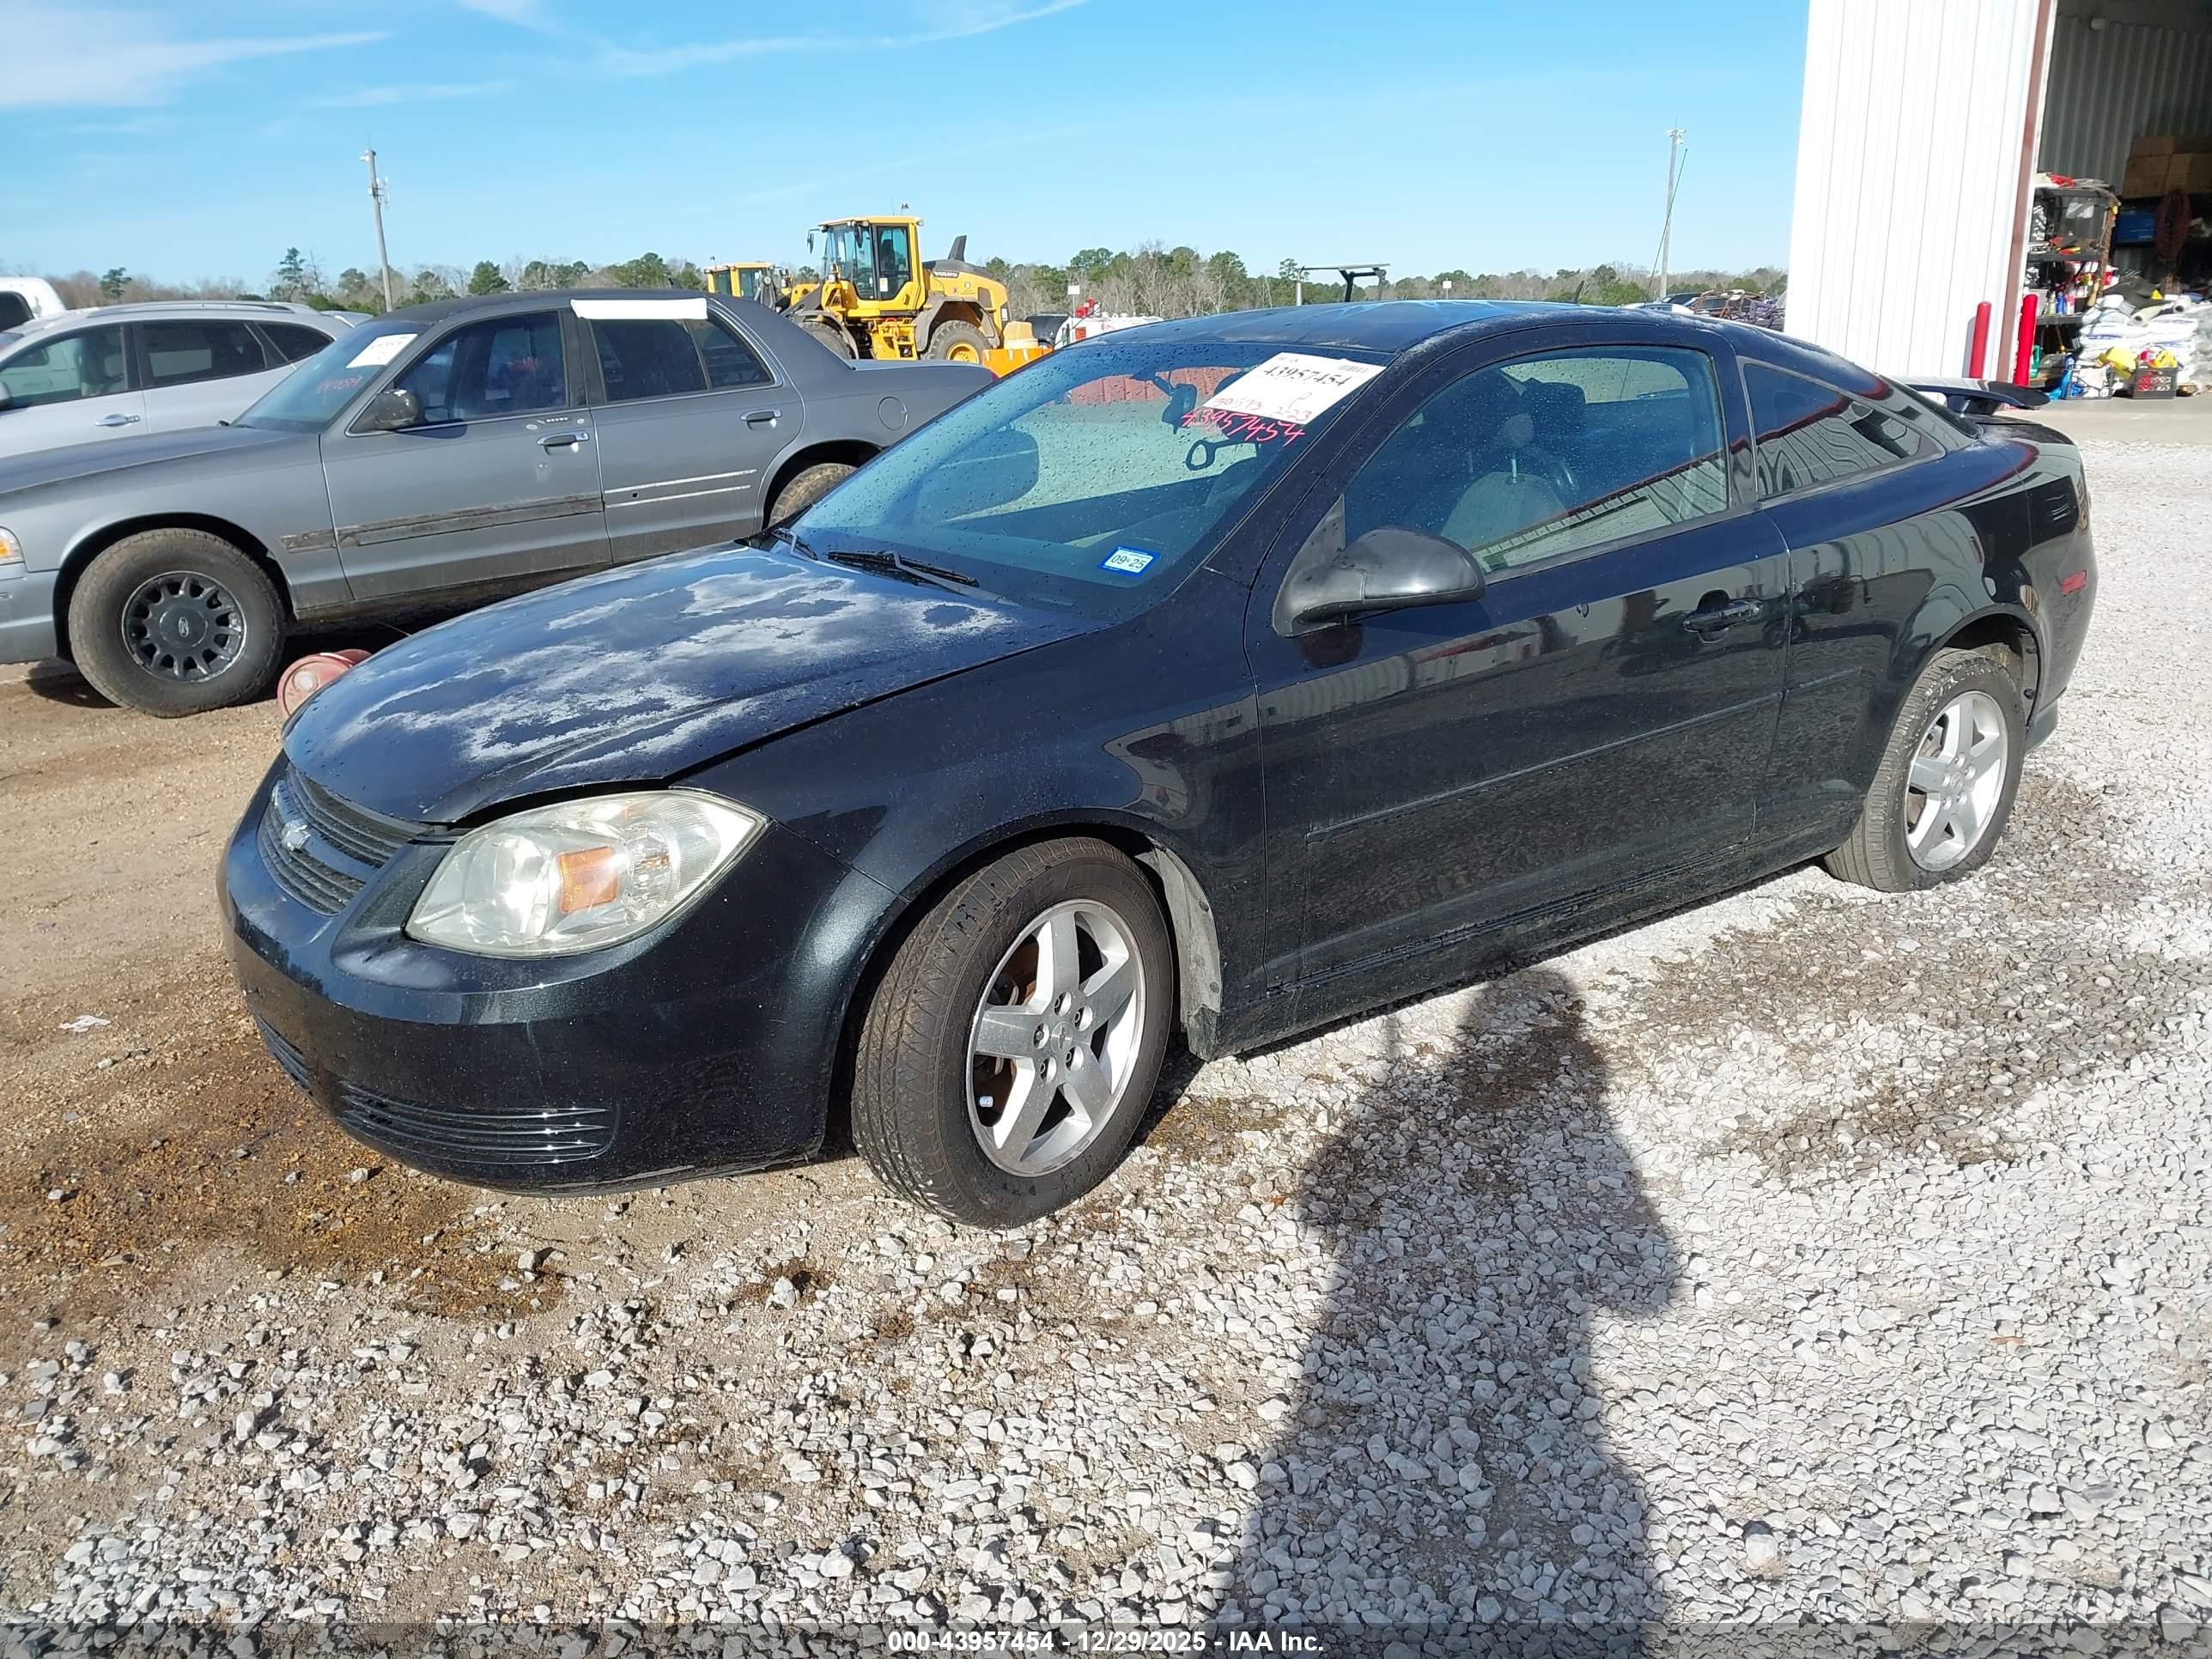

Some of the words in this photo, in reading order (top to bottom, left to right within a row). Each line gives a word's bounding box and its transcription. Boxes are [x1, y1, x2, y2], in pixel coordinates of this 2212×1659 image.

[1264, 365, 1352, 386] 43957454
[1181, 408, 1306, 447] 43957454
[1111, 555, 1127, 564] 09
[1128, 558, 1147, 569] 25
